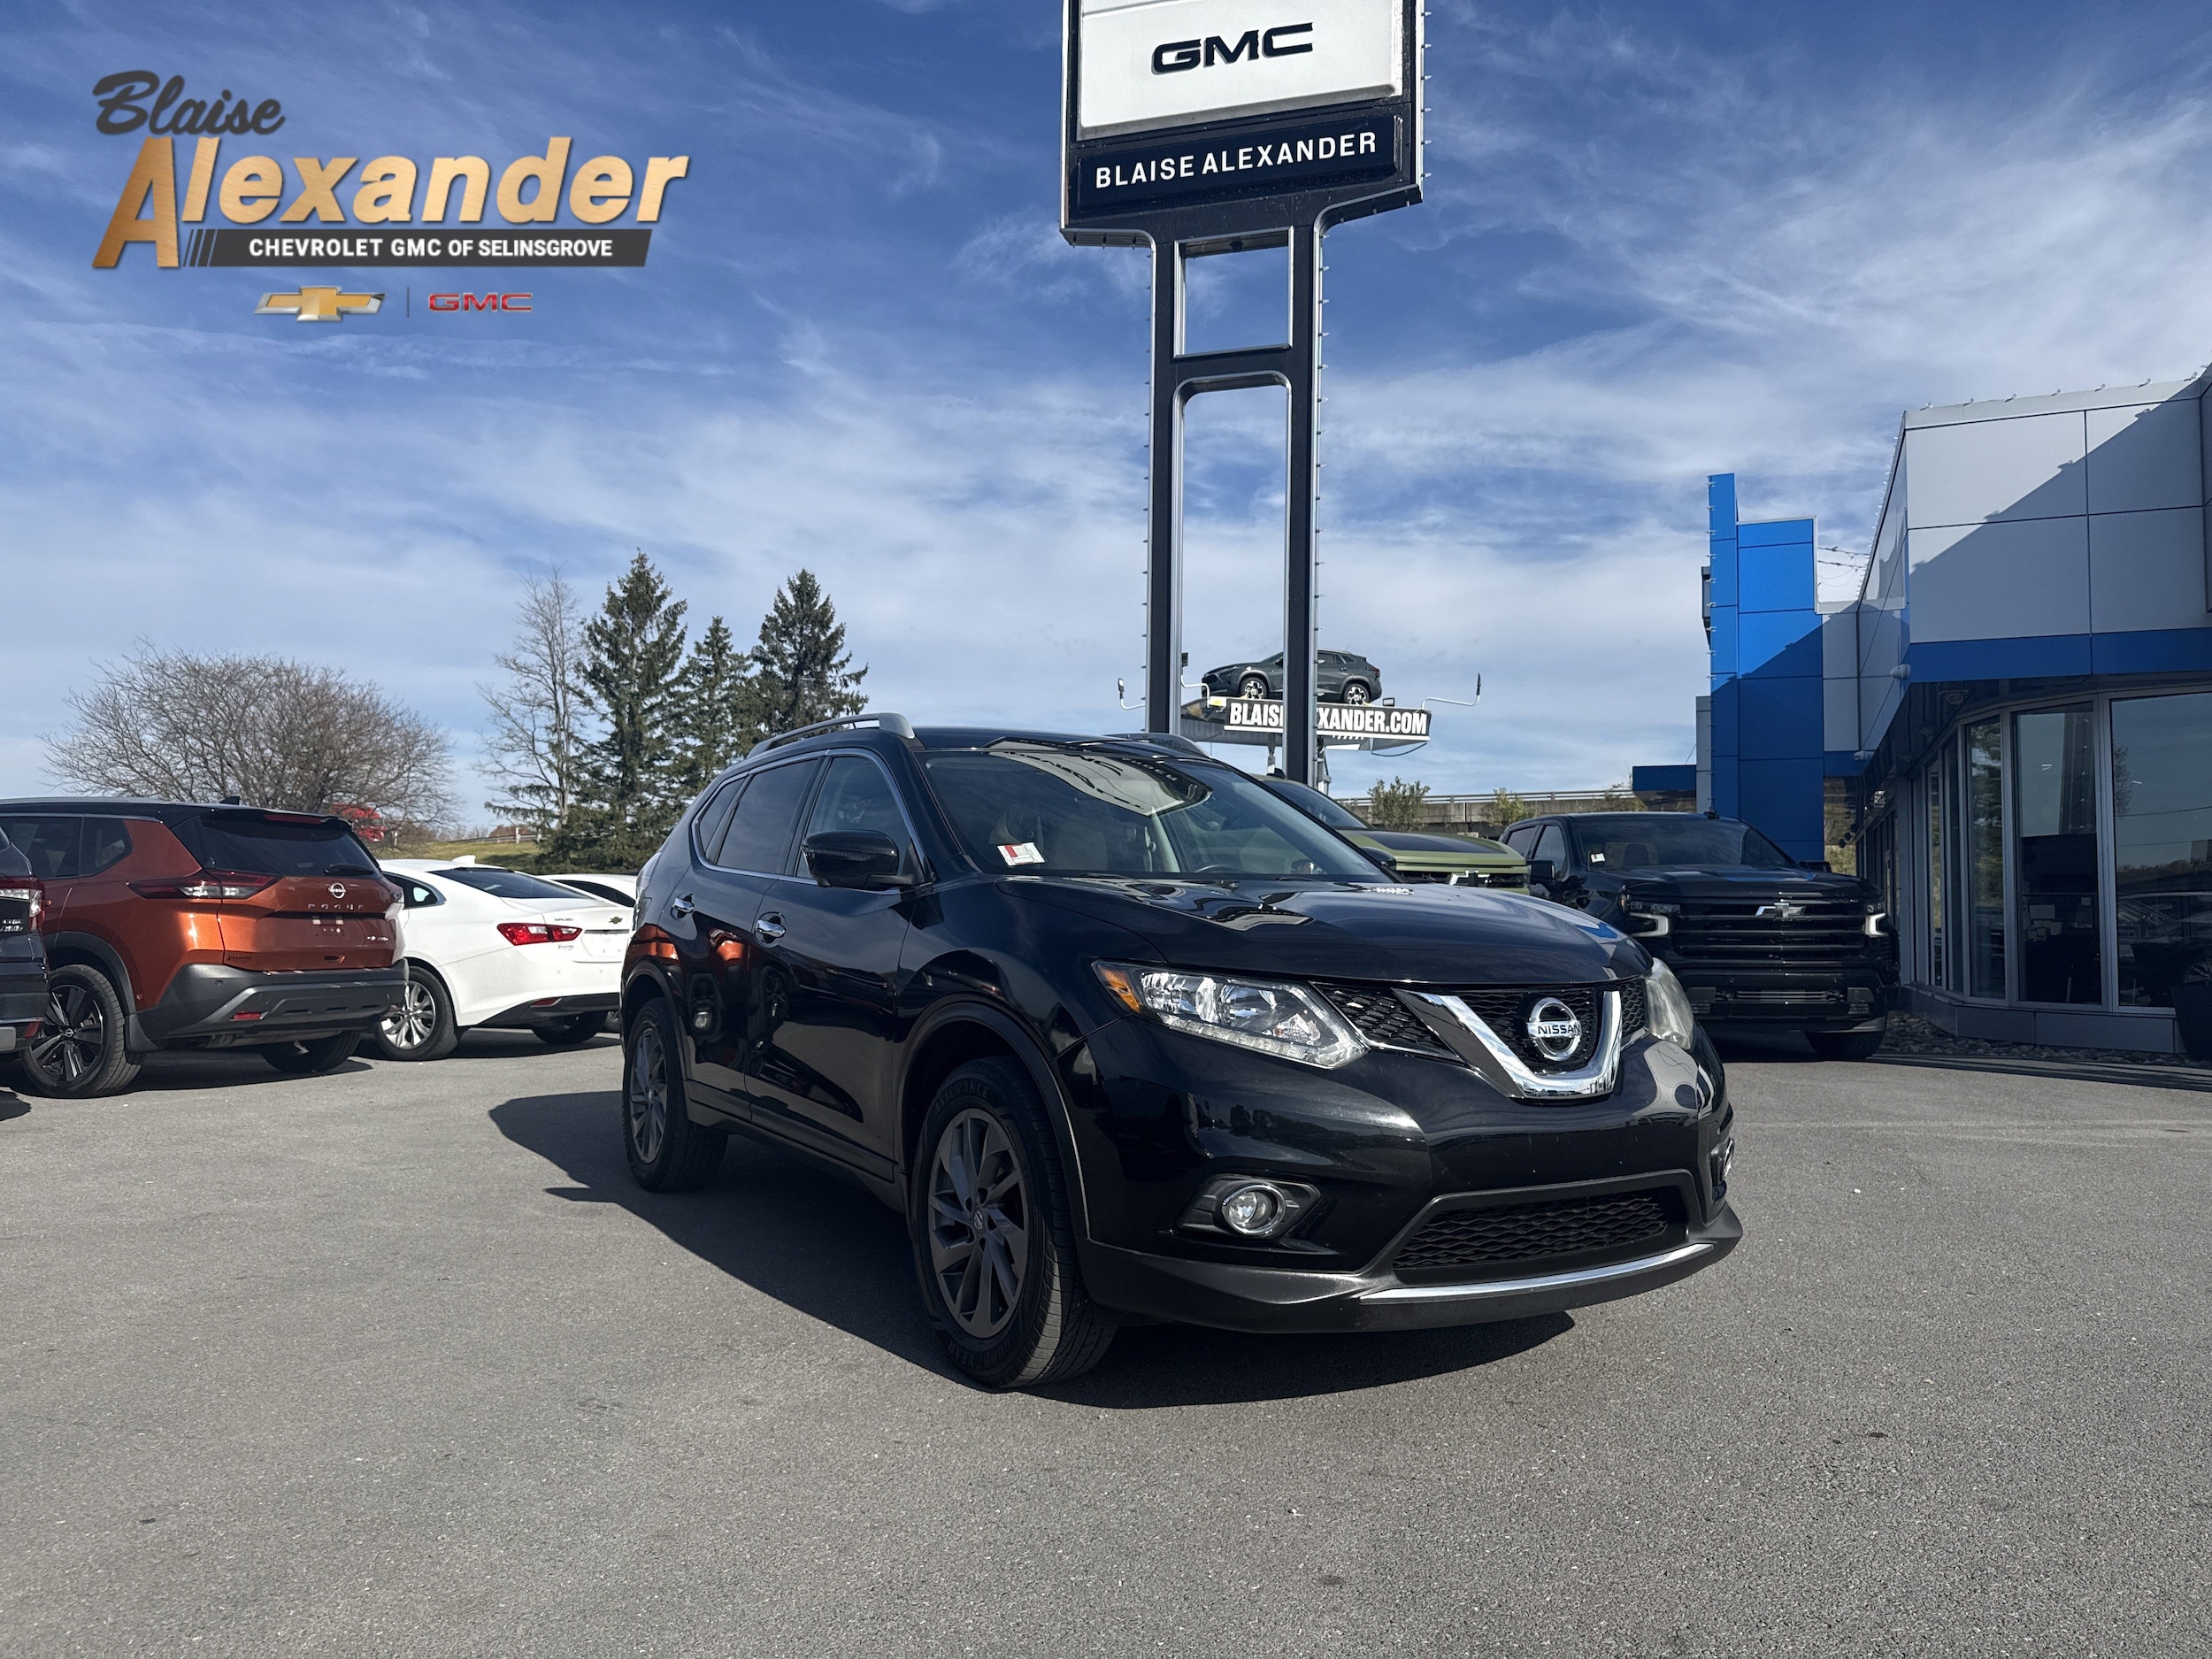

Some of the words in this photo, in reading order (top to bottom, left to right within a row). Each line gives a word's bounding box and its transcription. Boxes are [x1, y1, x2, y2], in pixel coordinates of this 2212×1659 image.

[1151, 22, 1313, 75] GMC
[1095, 154, 1194, 189] BLAISE
[1202, 131, 1376, 175] ALEXANDER
[1537, 1024, 1581, 1034] NISSAN
